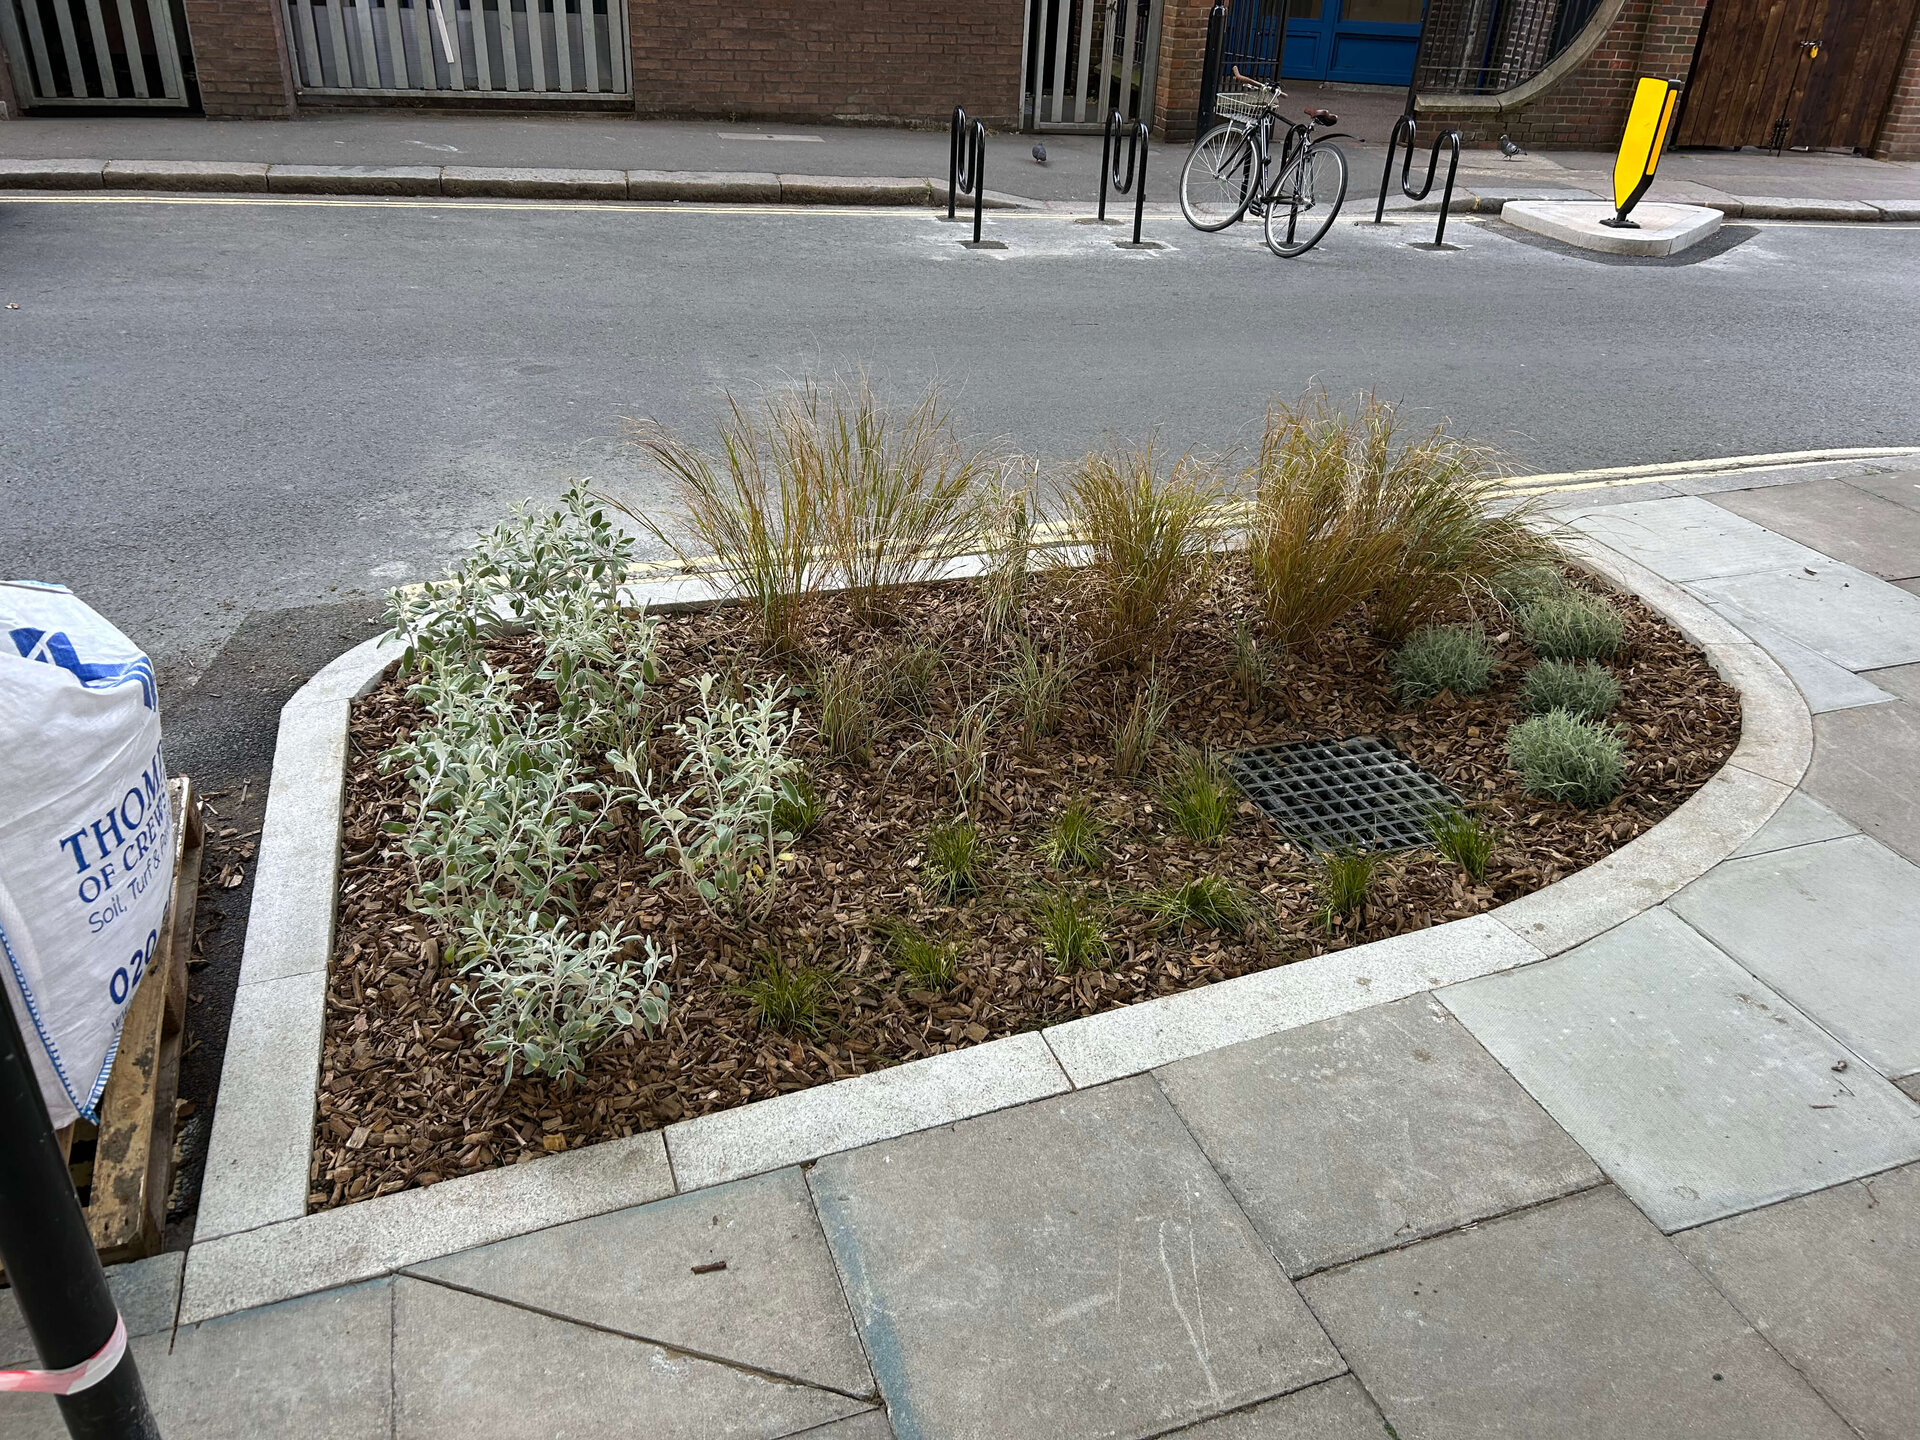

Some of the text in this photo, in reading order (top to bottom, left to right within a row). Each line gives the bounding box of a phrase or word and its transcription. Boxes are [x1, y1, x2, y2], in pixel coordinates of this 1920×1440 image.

[79, 863, 116, 904] OF
[88, 894, 128, 934] Soil,
[127, 858, 153, 900] Turf
[109, 928, 157, 1005] 020
